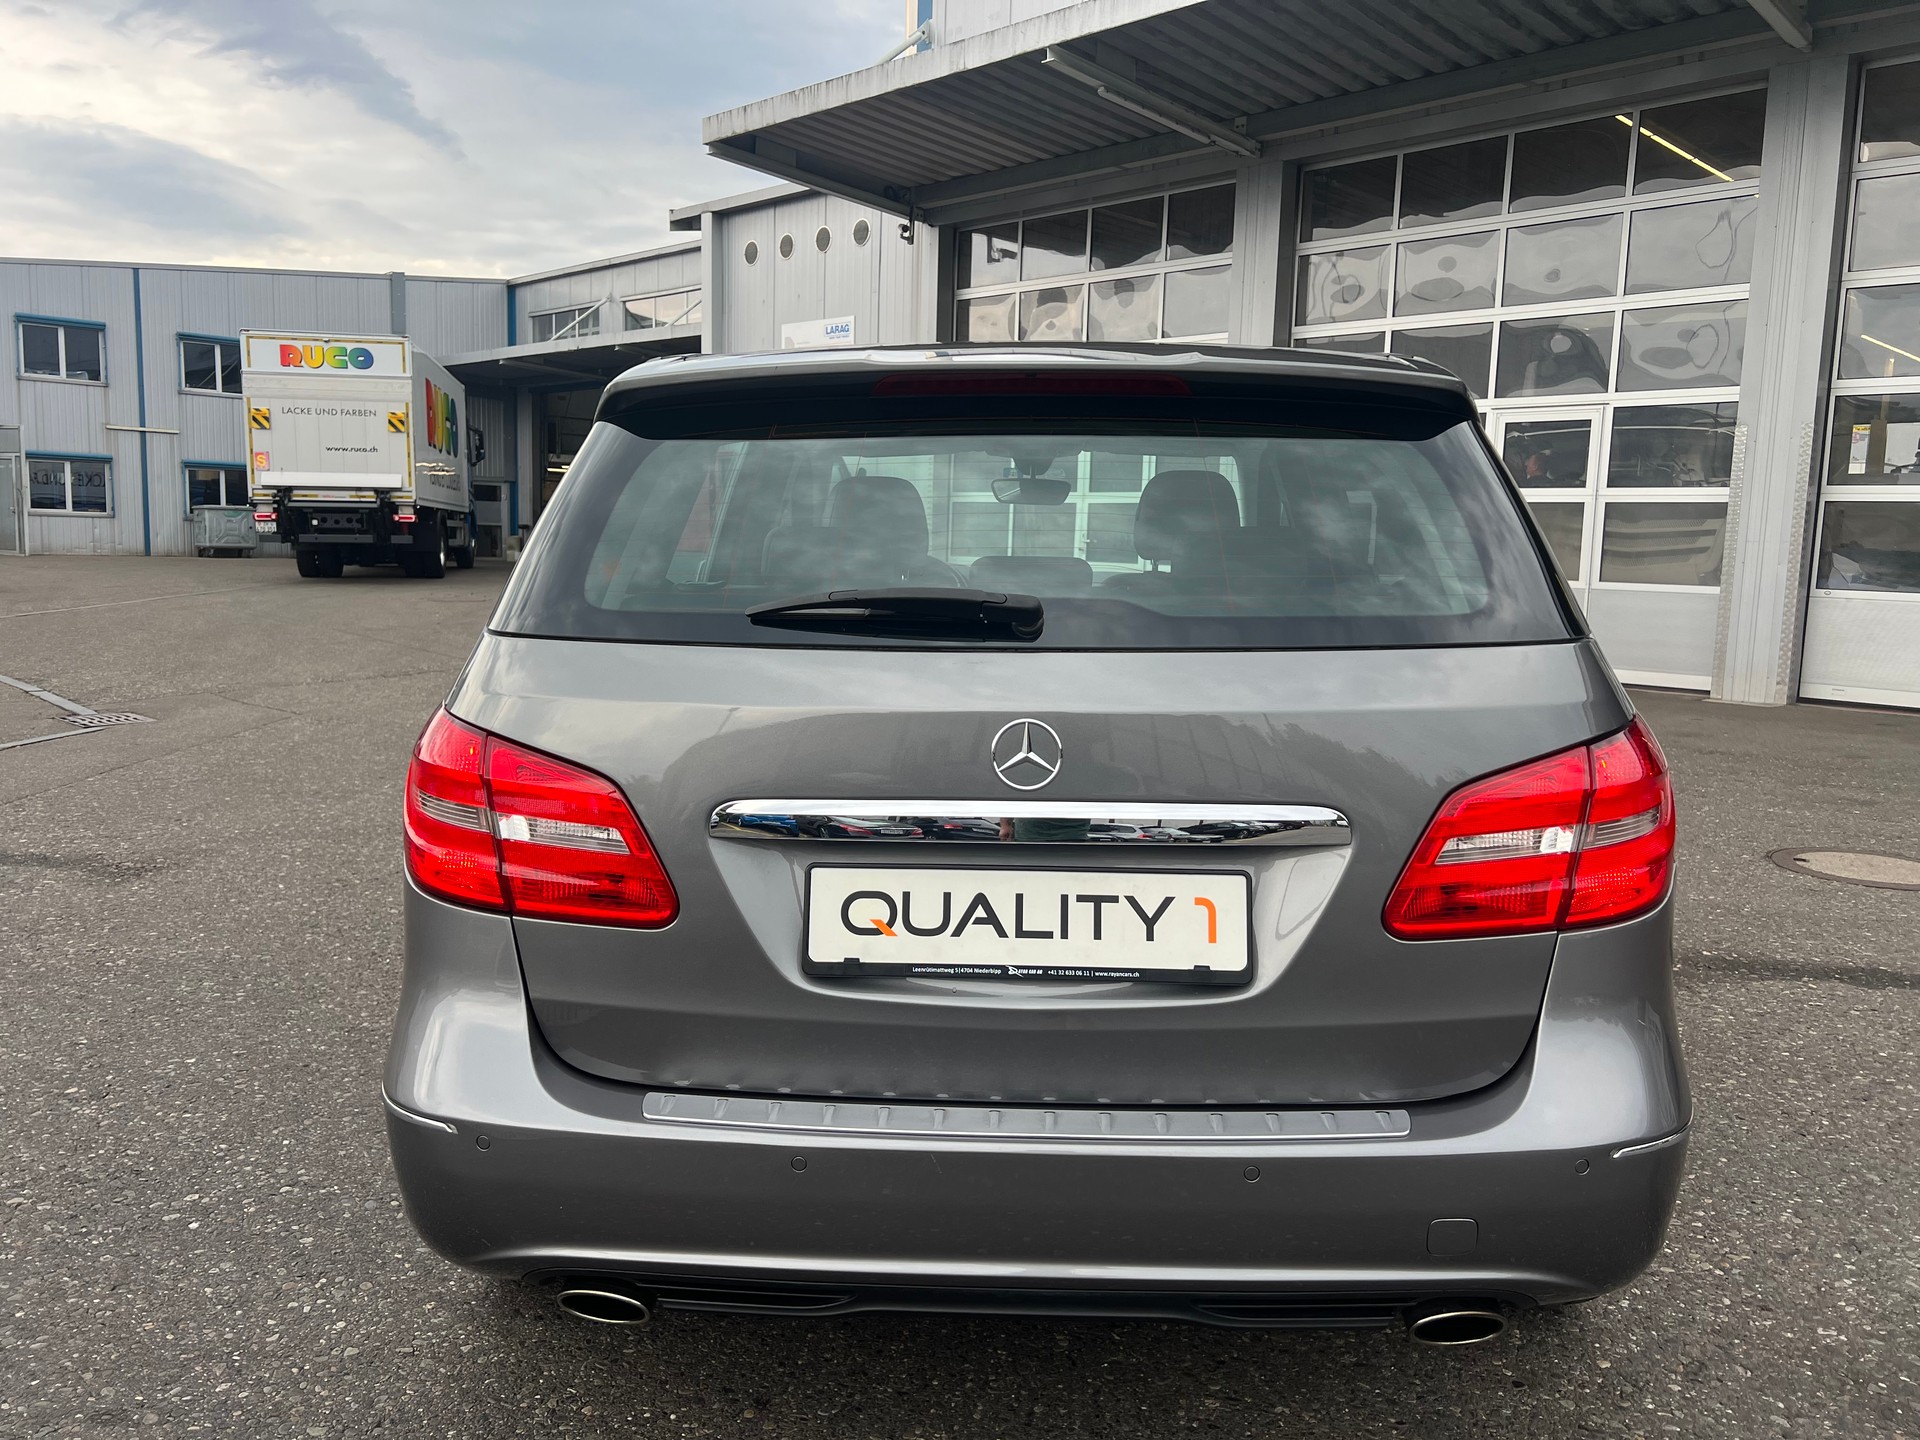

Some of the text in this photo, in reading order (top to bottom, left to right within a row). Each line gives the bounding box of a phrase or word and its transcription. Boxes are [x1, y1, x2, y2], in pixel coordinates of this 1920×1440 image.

[825, 323, 850, 335] LARAG
[279, 344, 374, 370] RUCO
[281, 406, 377, 418] LACKE UND FARBEN
[425, 377, 459, 459] RUCO
[325, 445, 378, 453] www.ruco.ch
[840, 890, 1176, 942] QUALITY
[973, 968, 1002, 976] Niederbipp
[1065, 969, 1075, 977] 633
